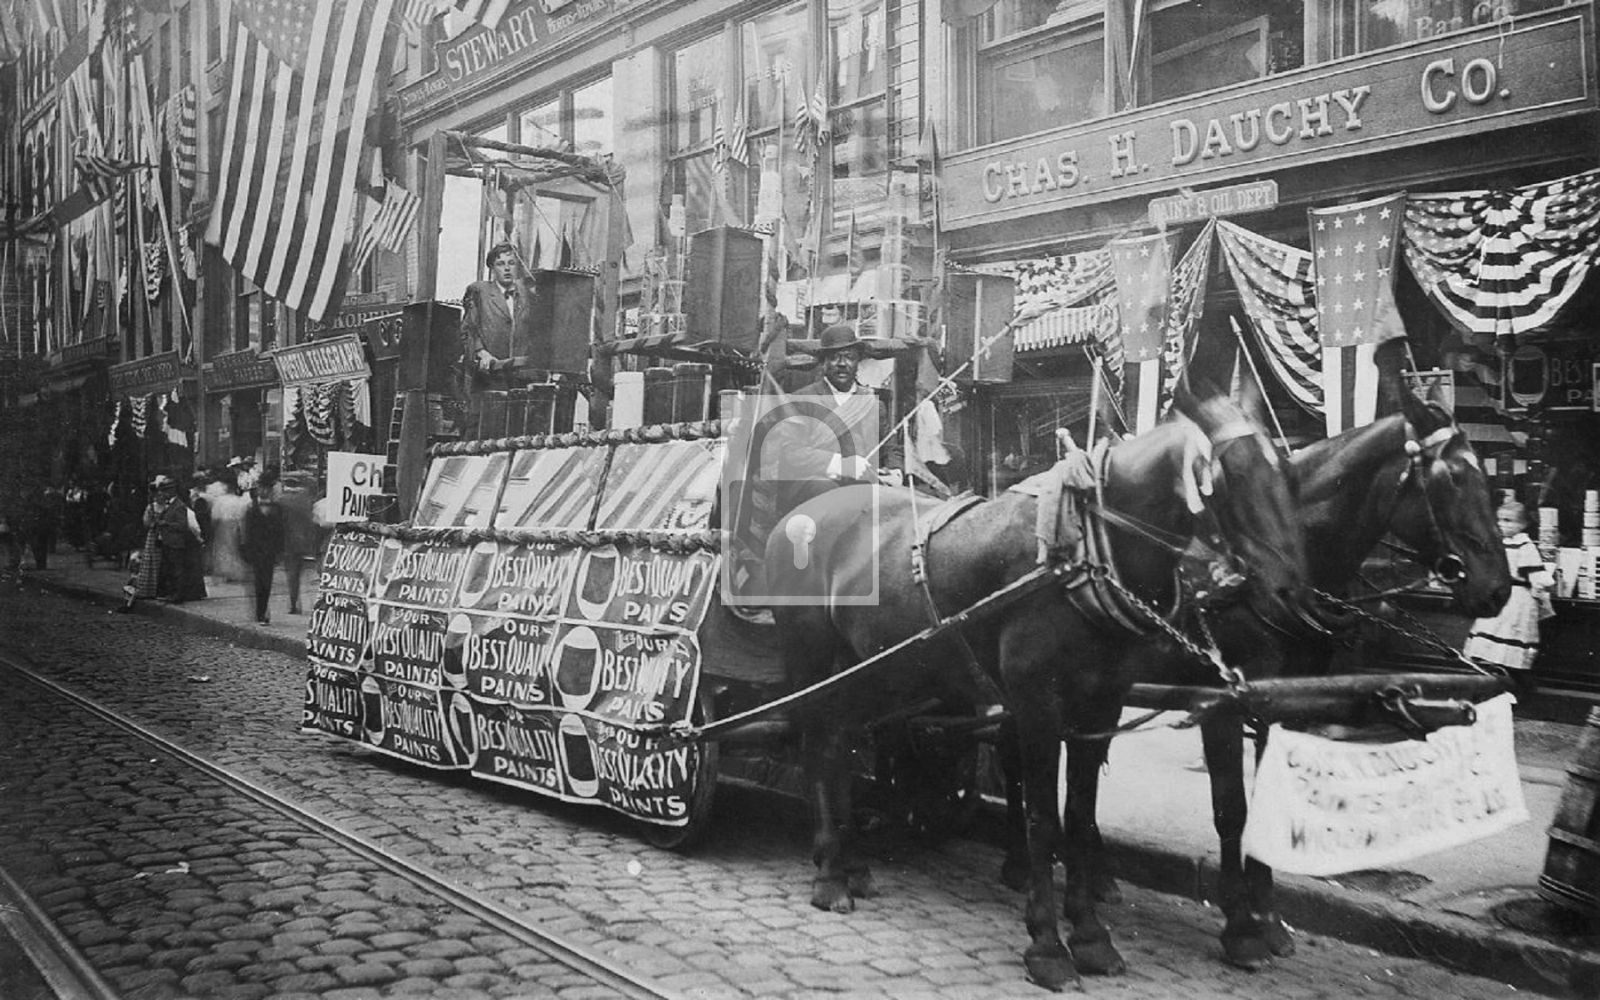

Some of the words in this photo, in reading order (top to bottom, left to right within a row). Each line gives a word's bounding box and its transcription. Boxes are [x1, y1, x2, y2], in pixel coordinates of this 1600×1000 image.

[446, 6, 538, 82] STEWART
[983, 151, 1089, 202] CHAS.
[1108, 130, 1149, 178] H.
[1170, 85, 1370, 166] DAUCHY
[1421, 58, 1510, 113] CO.
[306, 342, 364, 377] TELEGRAPH
[617, 556, 652, 597] BEST
[398, 585, 449, 604] PAINTS
[504, 619, 540, 637] OUR
[469, 633, 507, 671] BEST
[384, 660, 439, 686] PAINTS
[601, 648, 639, 691] BEST
[481, 675, 545, 702] PAINS
[394, 734, 441, 762] PAINTS
[494, 755, 556, 788] PAINTS
[609, 786, 686, 816] PAINTS
